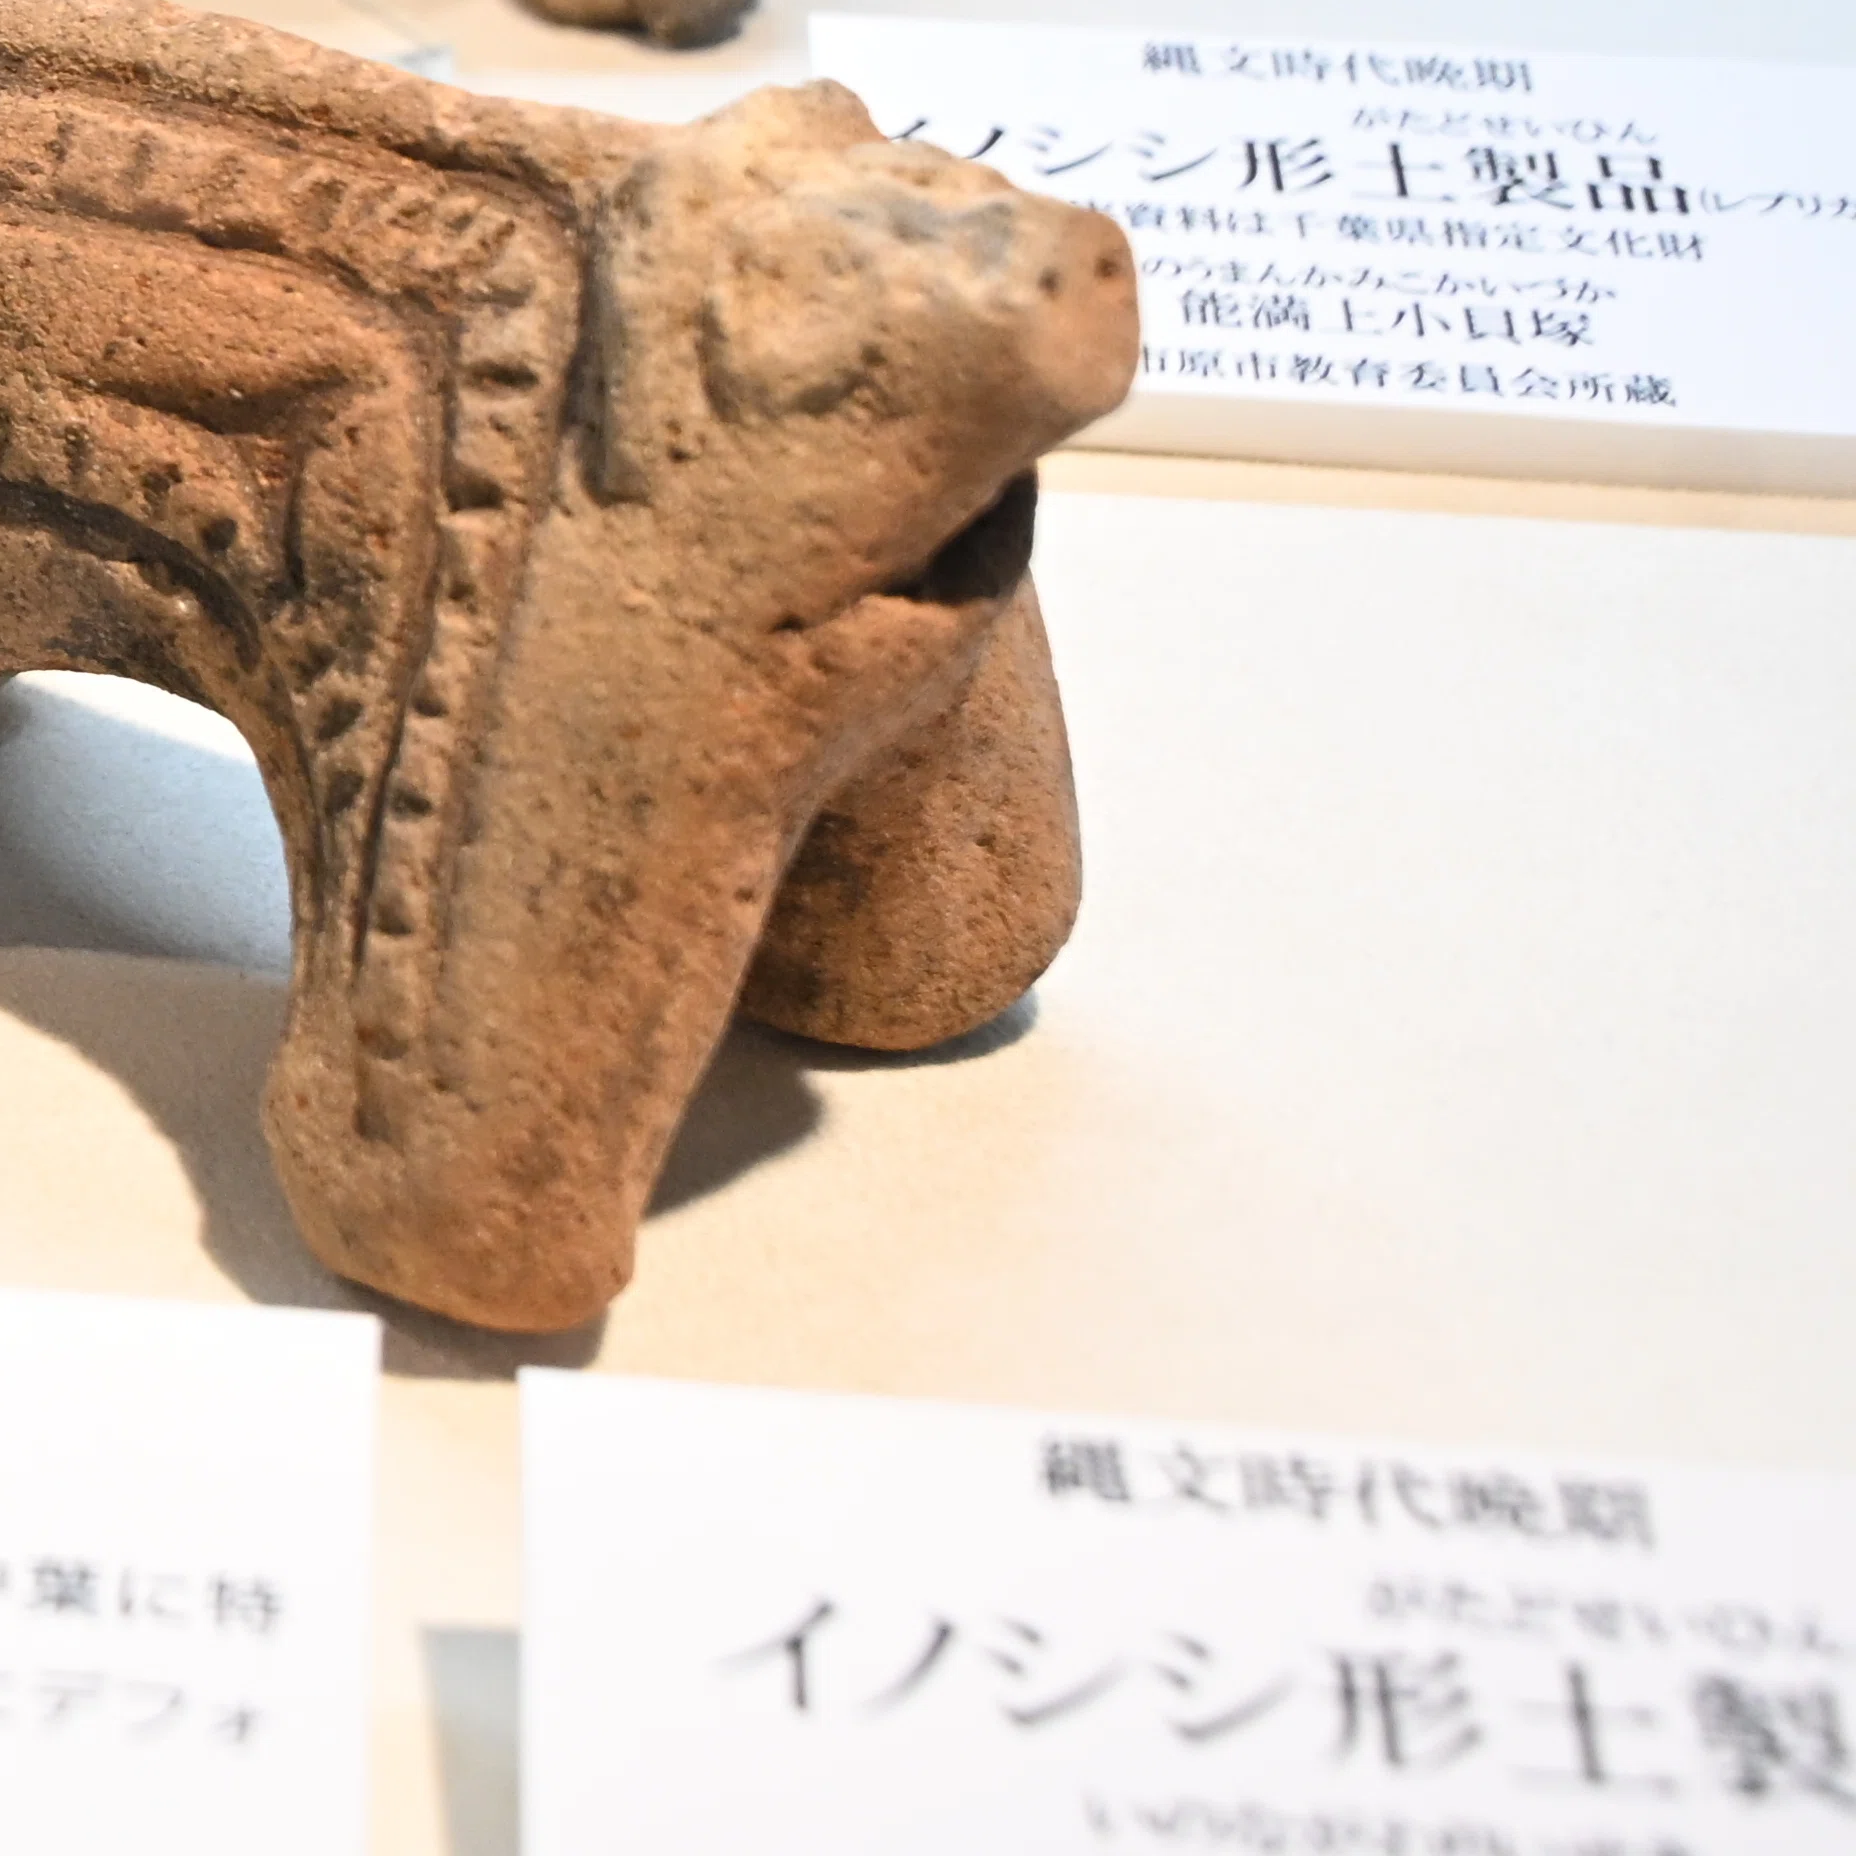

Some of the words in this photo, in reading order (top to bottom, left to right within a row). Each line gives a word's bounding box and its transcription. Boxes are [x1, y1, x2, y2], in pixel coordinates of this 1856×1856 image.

[1142, 41, 1532, 94] 縄文時代晩期
[1071, 200, 1704, 262] 資料は千葉県指定文化財
[1038, 1430, 1658, 1551] 縄文時代晩期
